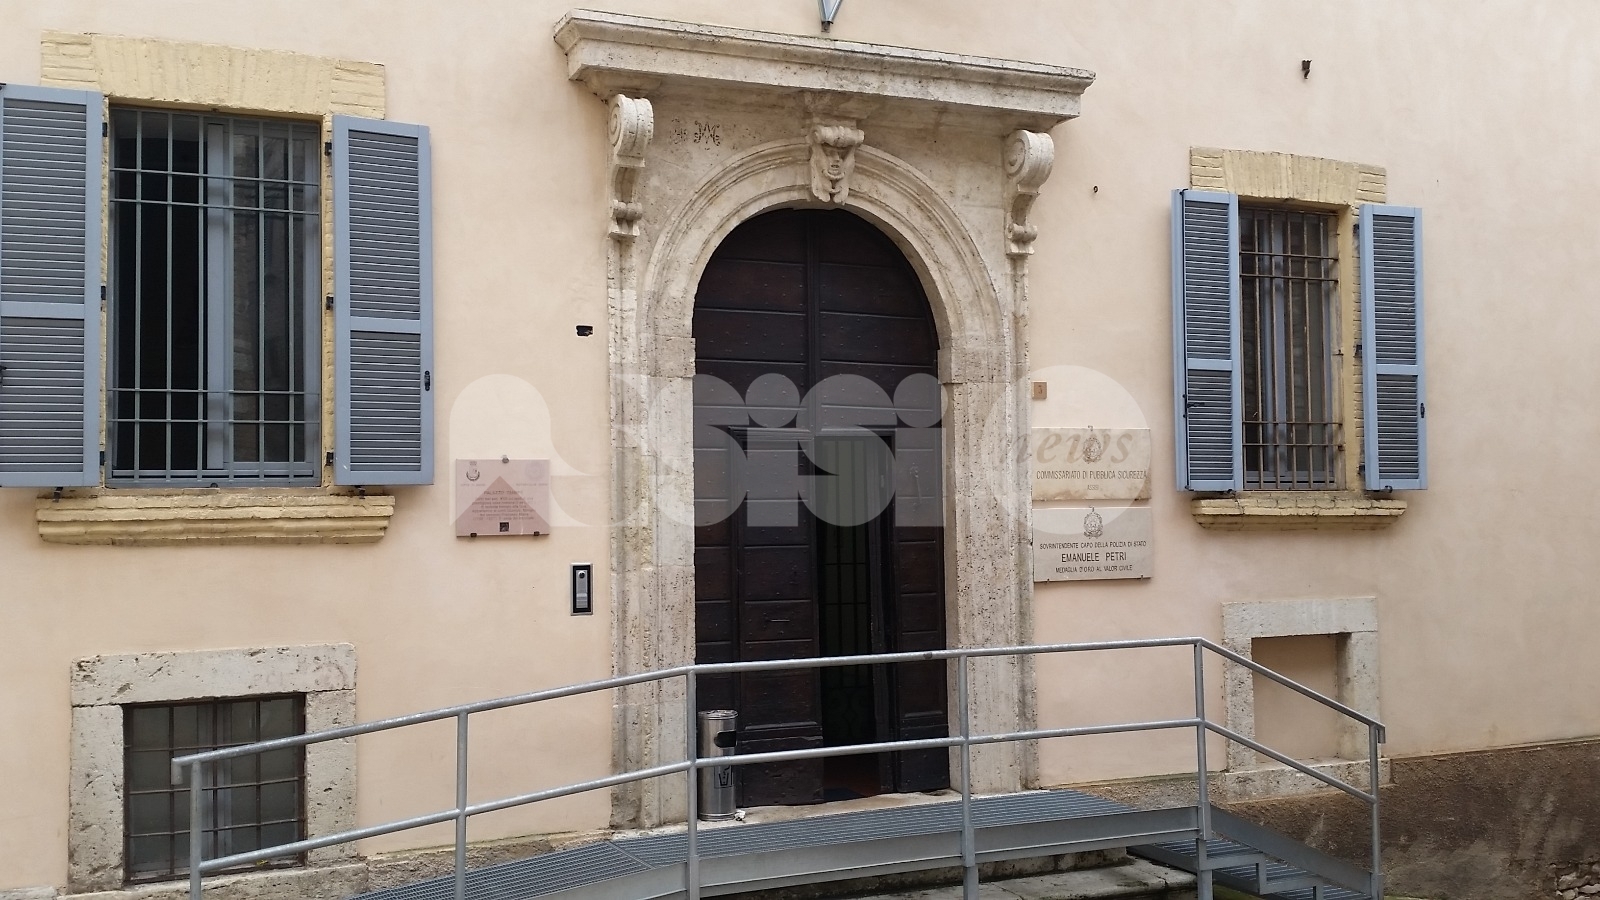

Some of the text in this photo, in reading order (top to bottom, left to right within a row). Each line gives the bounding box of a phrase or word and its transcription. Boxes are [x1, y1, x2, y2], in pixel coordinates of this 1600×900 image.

[1036, 470, 1148, 480] COMMISSARIATO DI PUBBLICA SICUREZZA
[1039, 542, 1079, 550] SOVRINTENDENTE
[1061, 551, 1127, 563] EMANUELE PETRI
[1055, 566, 1078, 574] MEDAGLIA
